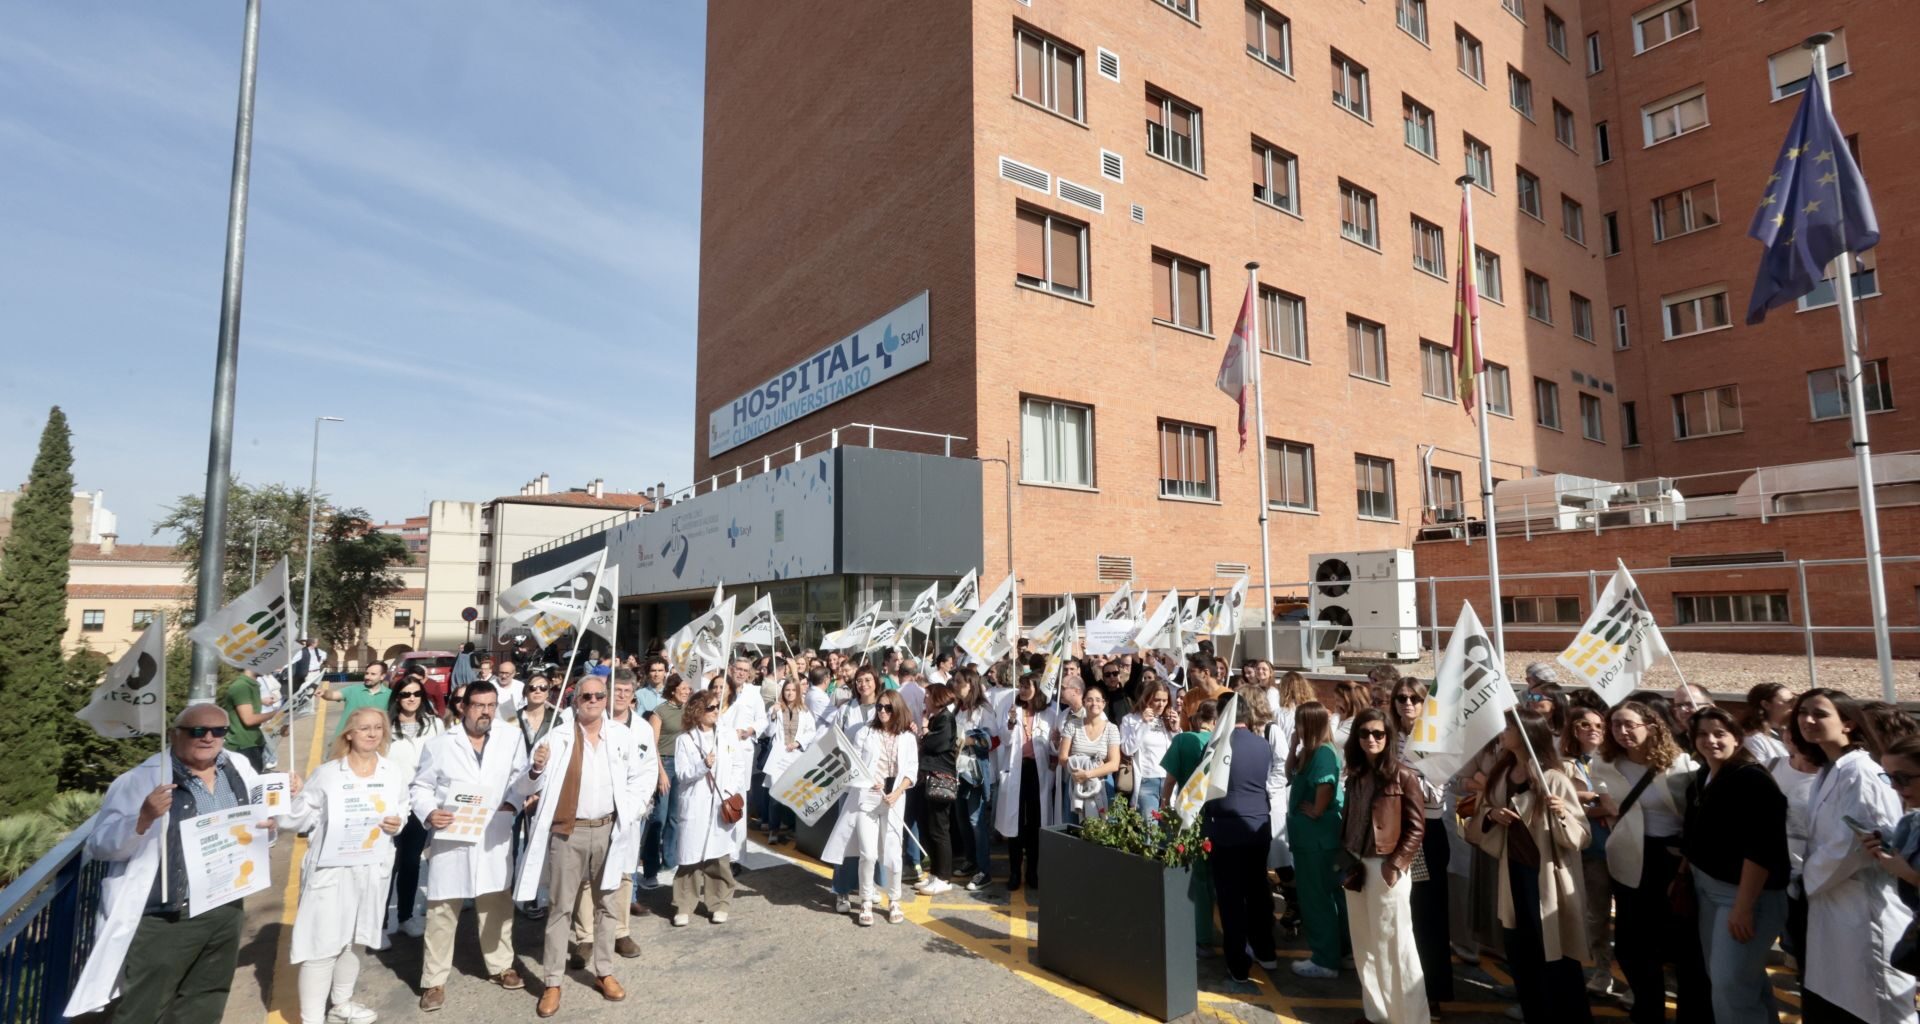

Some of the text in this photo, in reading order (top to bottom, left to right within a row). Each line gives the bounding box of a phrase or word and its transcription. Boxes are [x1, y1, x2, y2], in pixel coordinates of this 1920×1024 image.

[900, 323, 925, 347] Sacyl
[733, 334, 869, 427] HOSPITAL
[773, 365, 872, 425] UNIVERSITARIO
[266, 782, 284, 791] 13
